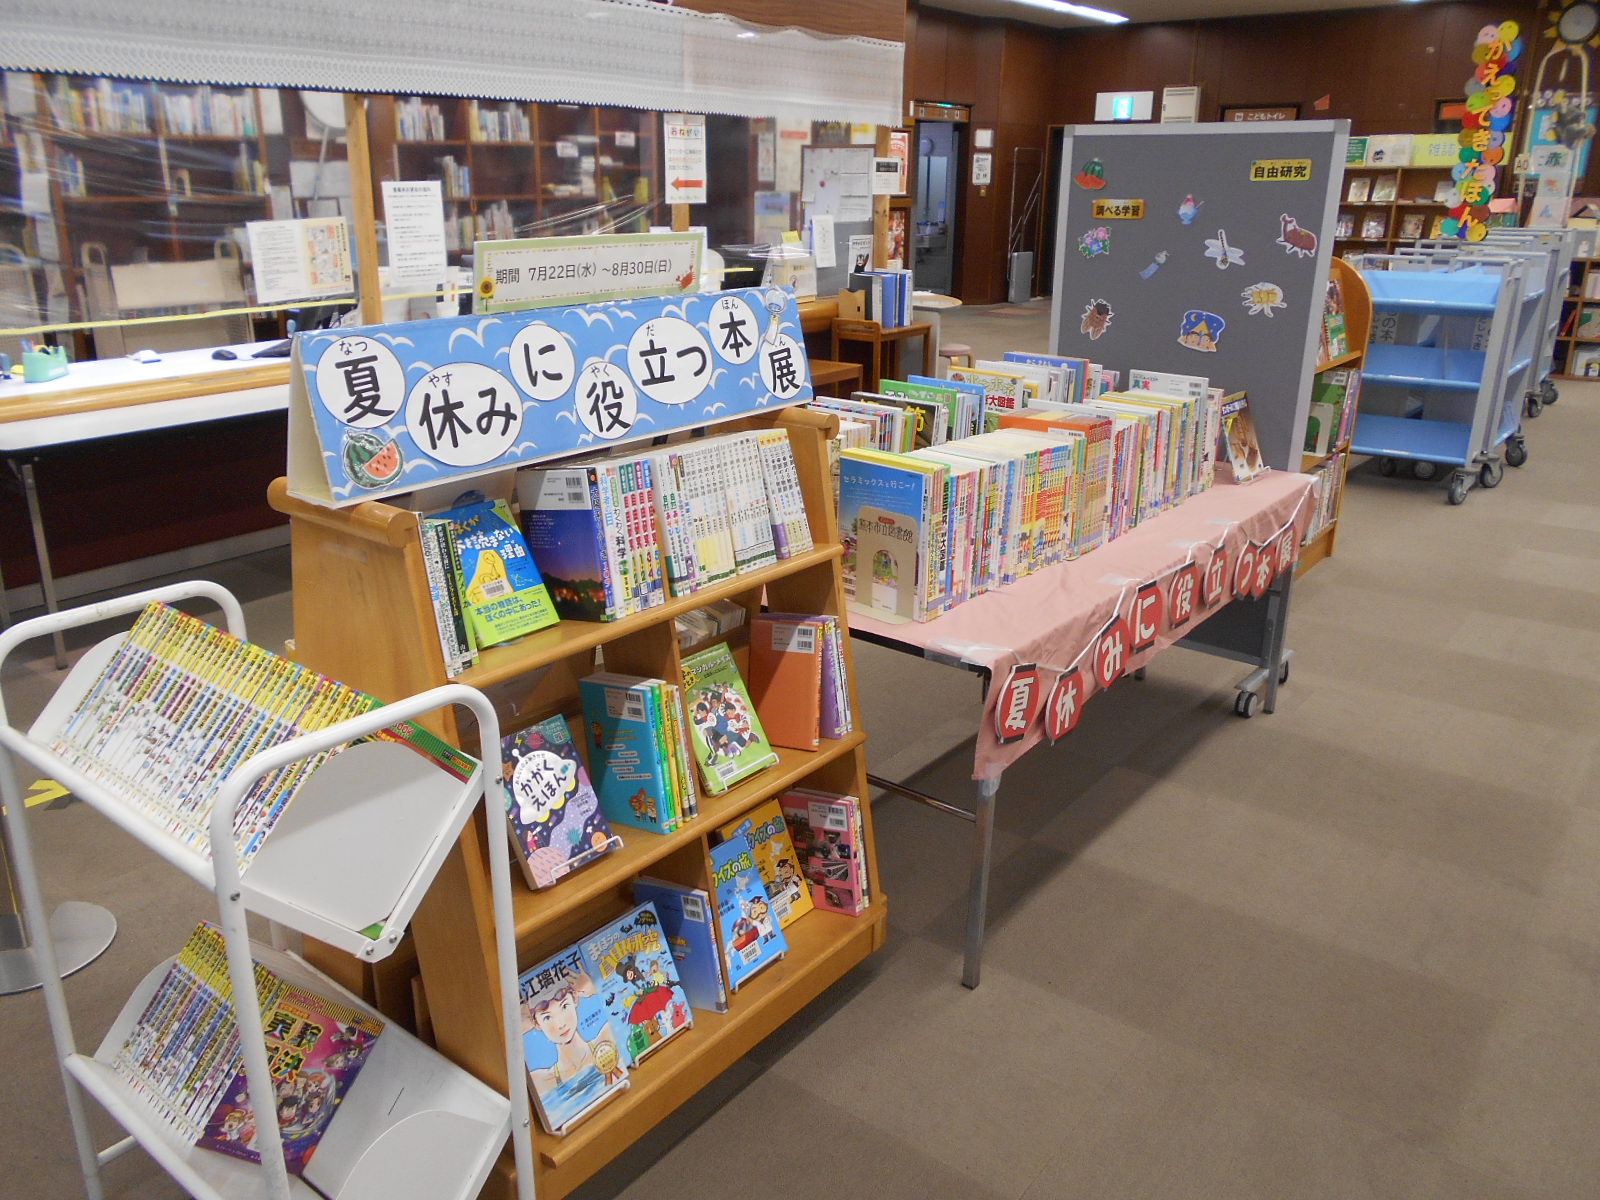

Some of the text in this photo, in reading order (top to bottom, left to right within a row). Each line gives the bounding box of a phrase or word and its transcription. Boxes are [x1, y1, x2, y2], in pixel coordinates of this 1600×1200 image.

[1247, 112, 1286, 121] こどもトイレ
[1254, 164, 1307, 179] 自由研究
[1096, 205, 1141, 217] 調べる学習
[495, 267, 520, 284] 期間
[721, 299, 739, 310] ほん
[338, 340, 369, 356] なつ
[590, 366, 611, 378] やく
[428, 371, 454, 389] やす
